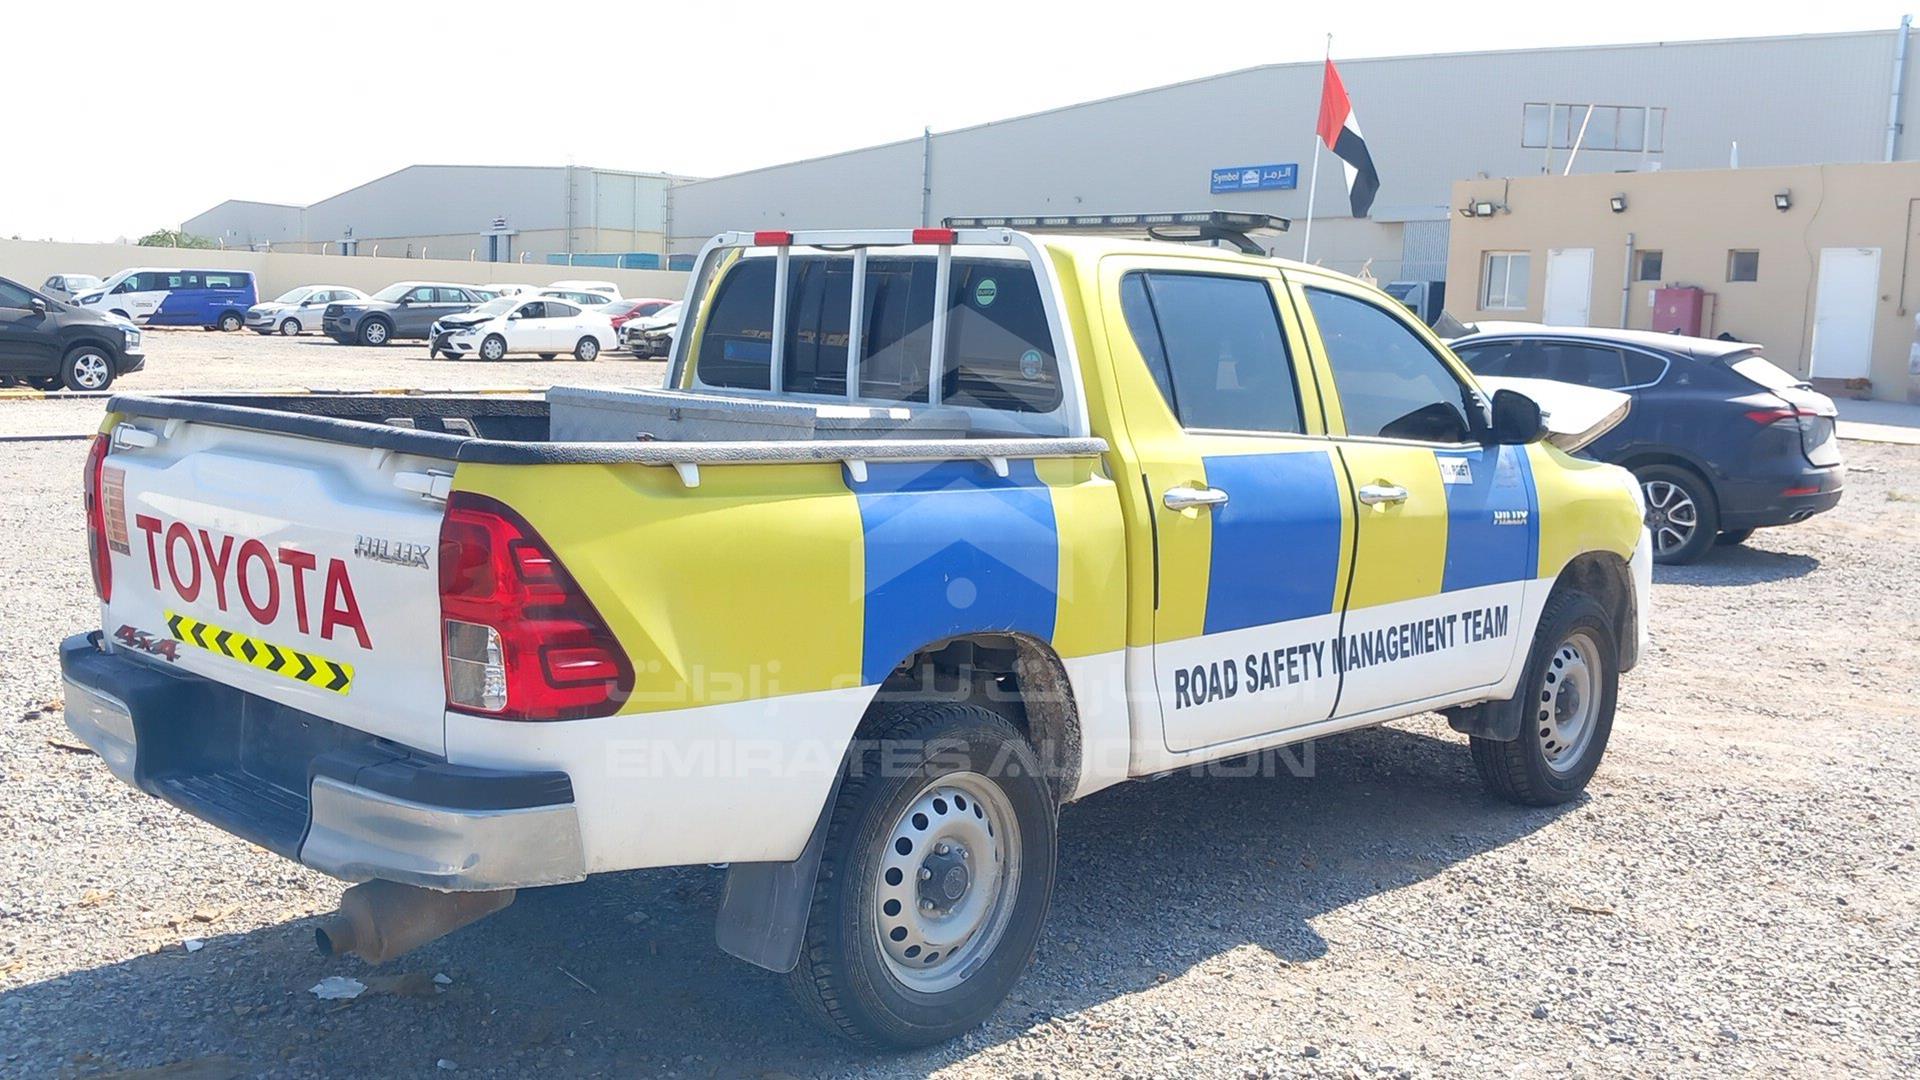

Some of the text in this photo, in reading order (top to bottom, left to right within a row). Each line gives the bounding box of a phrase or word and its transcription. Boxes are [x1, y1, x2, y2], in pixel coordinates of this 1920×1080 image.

[1213, 172, 1239, 184] Symbol
[1262, 167, 1291, 180] الرمز
[354, 534, 431, 569] HILUX
[135, 514, 373, 650] TOYOTA
[1174, 605, 1508, 709] ROAD SAFETY MANAGEMENT TEAM
